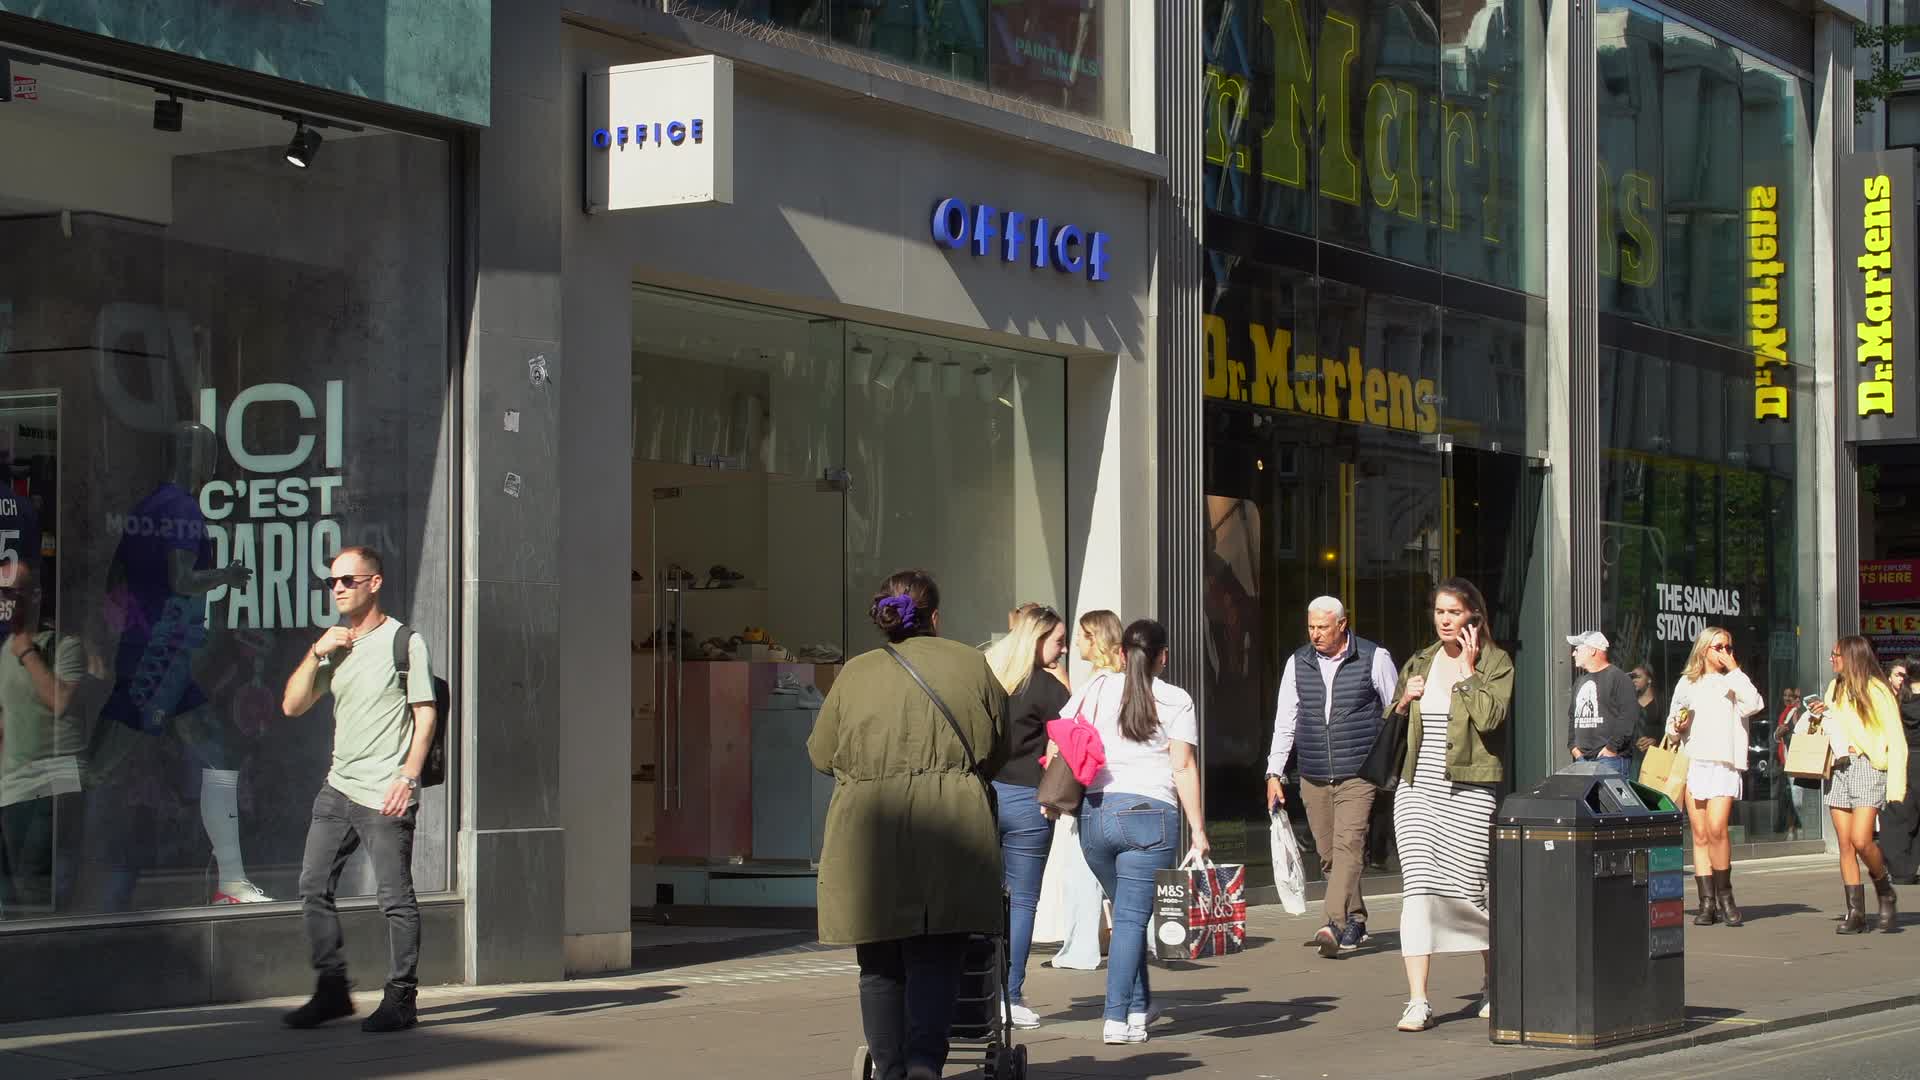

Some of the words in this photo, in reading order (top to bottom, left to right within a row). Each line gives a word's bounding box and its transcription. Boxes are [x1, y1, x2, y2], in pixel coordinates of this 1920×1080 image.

[592, 119, 703, 148] OFFICE
[932, 197, 1111, 281] OFFICE
[200, 379, 344, 474] ICI
[204, 519, 343, 631] PARIS
[1879, 571, 1912, 584] HERE
[1656, 583, 1682, 611] THE
[1684, 585, 1740, 616] SANDALS
[1656, 613, 1687, 641] STAY
[1157, 885, 1184, 897] M&S
[1198, 893, 1234, 920] M&S
